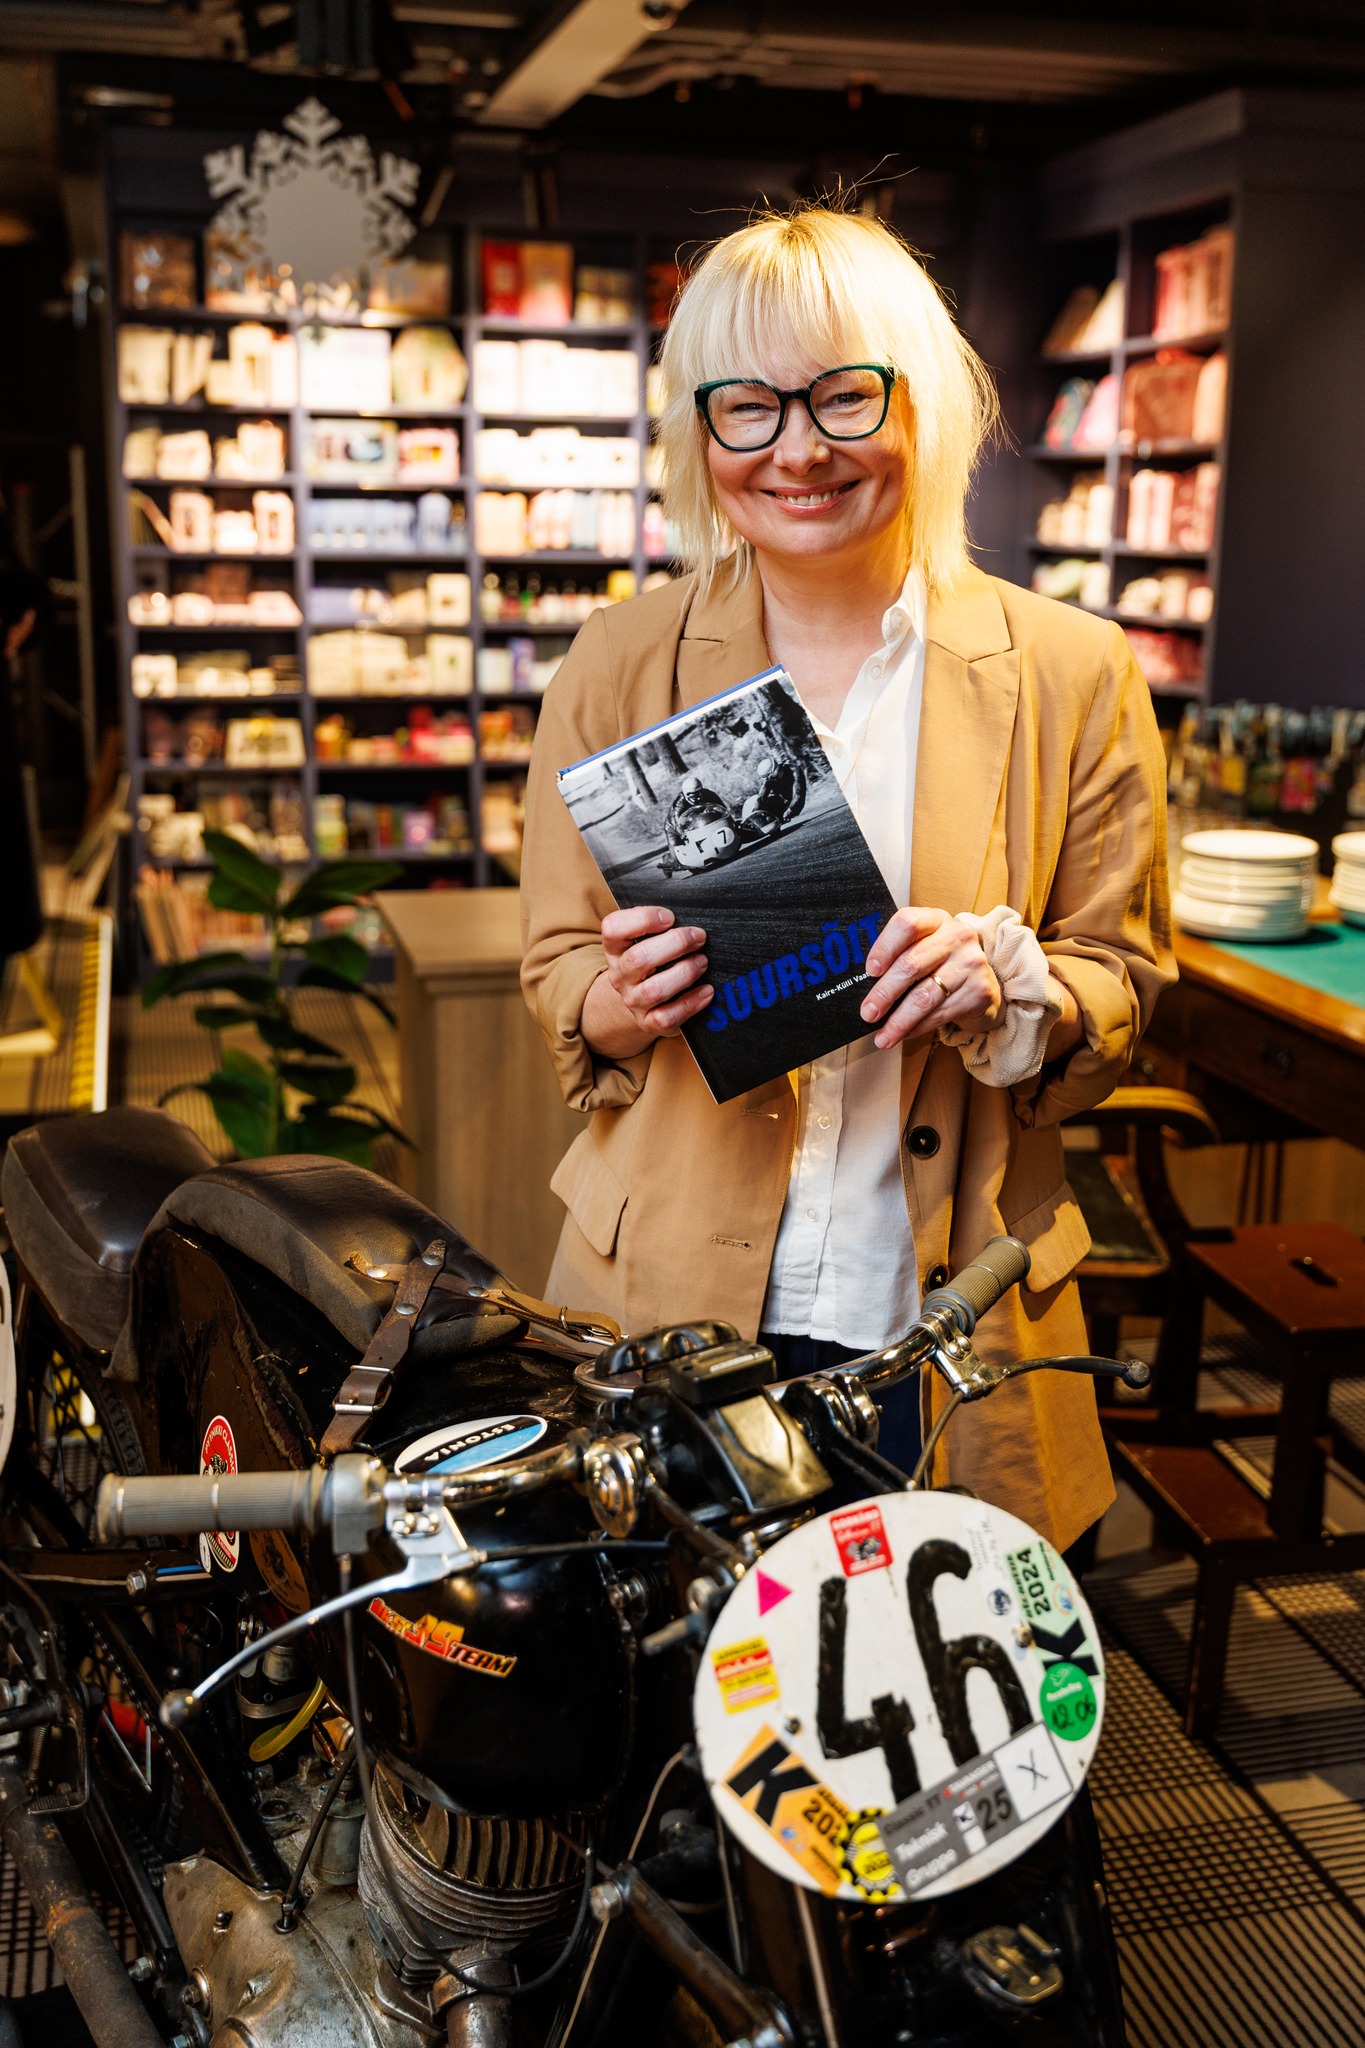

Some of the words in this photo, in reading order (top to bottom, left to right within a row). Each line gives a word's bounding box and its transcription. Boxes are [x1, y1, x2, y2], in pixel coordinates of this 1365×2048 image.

[706, 912, 882, 1032] SUURSÕIT
[816, 978, 854, 1001] Kaire-Külli
[853, 971, 871, 987] Vaat
[424, 1423, 516, 1462] ESTONIA
[1015, 1547, 1052, 1616] 2024
[448, 1641, 517, 1678] TEAM
[815, 1538, 1035, 1804] 46
[726, 1739, 821, 1828] K
[977, 1786, 1012, 1831] 25
[894, 1821, 948, 1864] Teknisk
[905, 1848, 959, 1890] Gruppe
